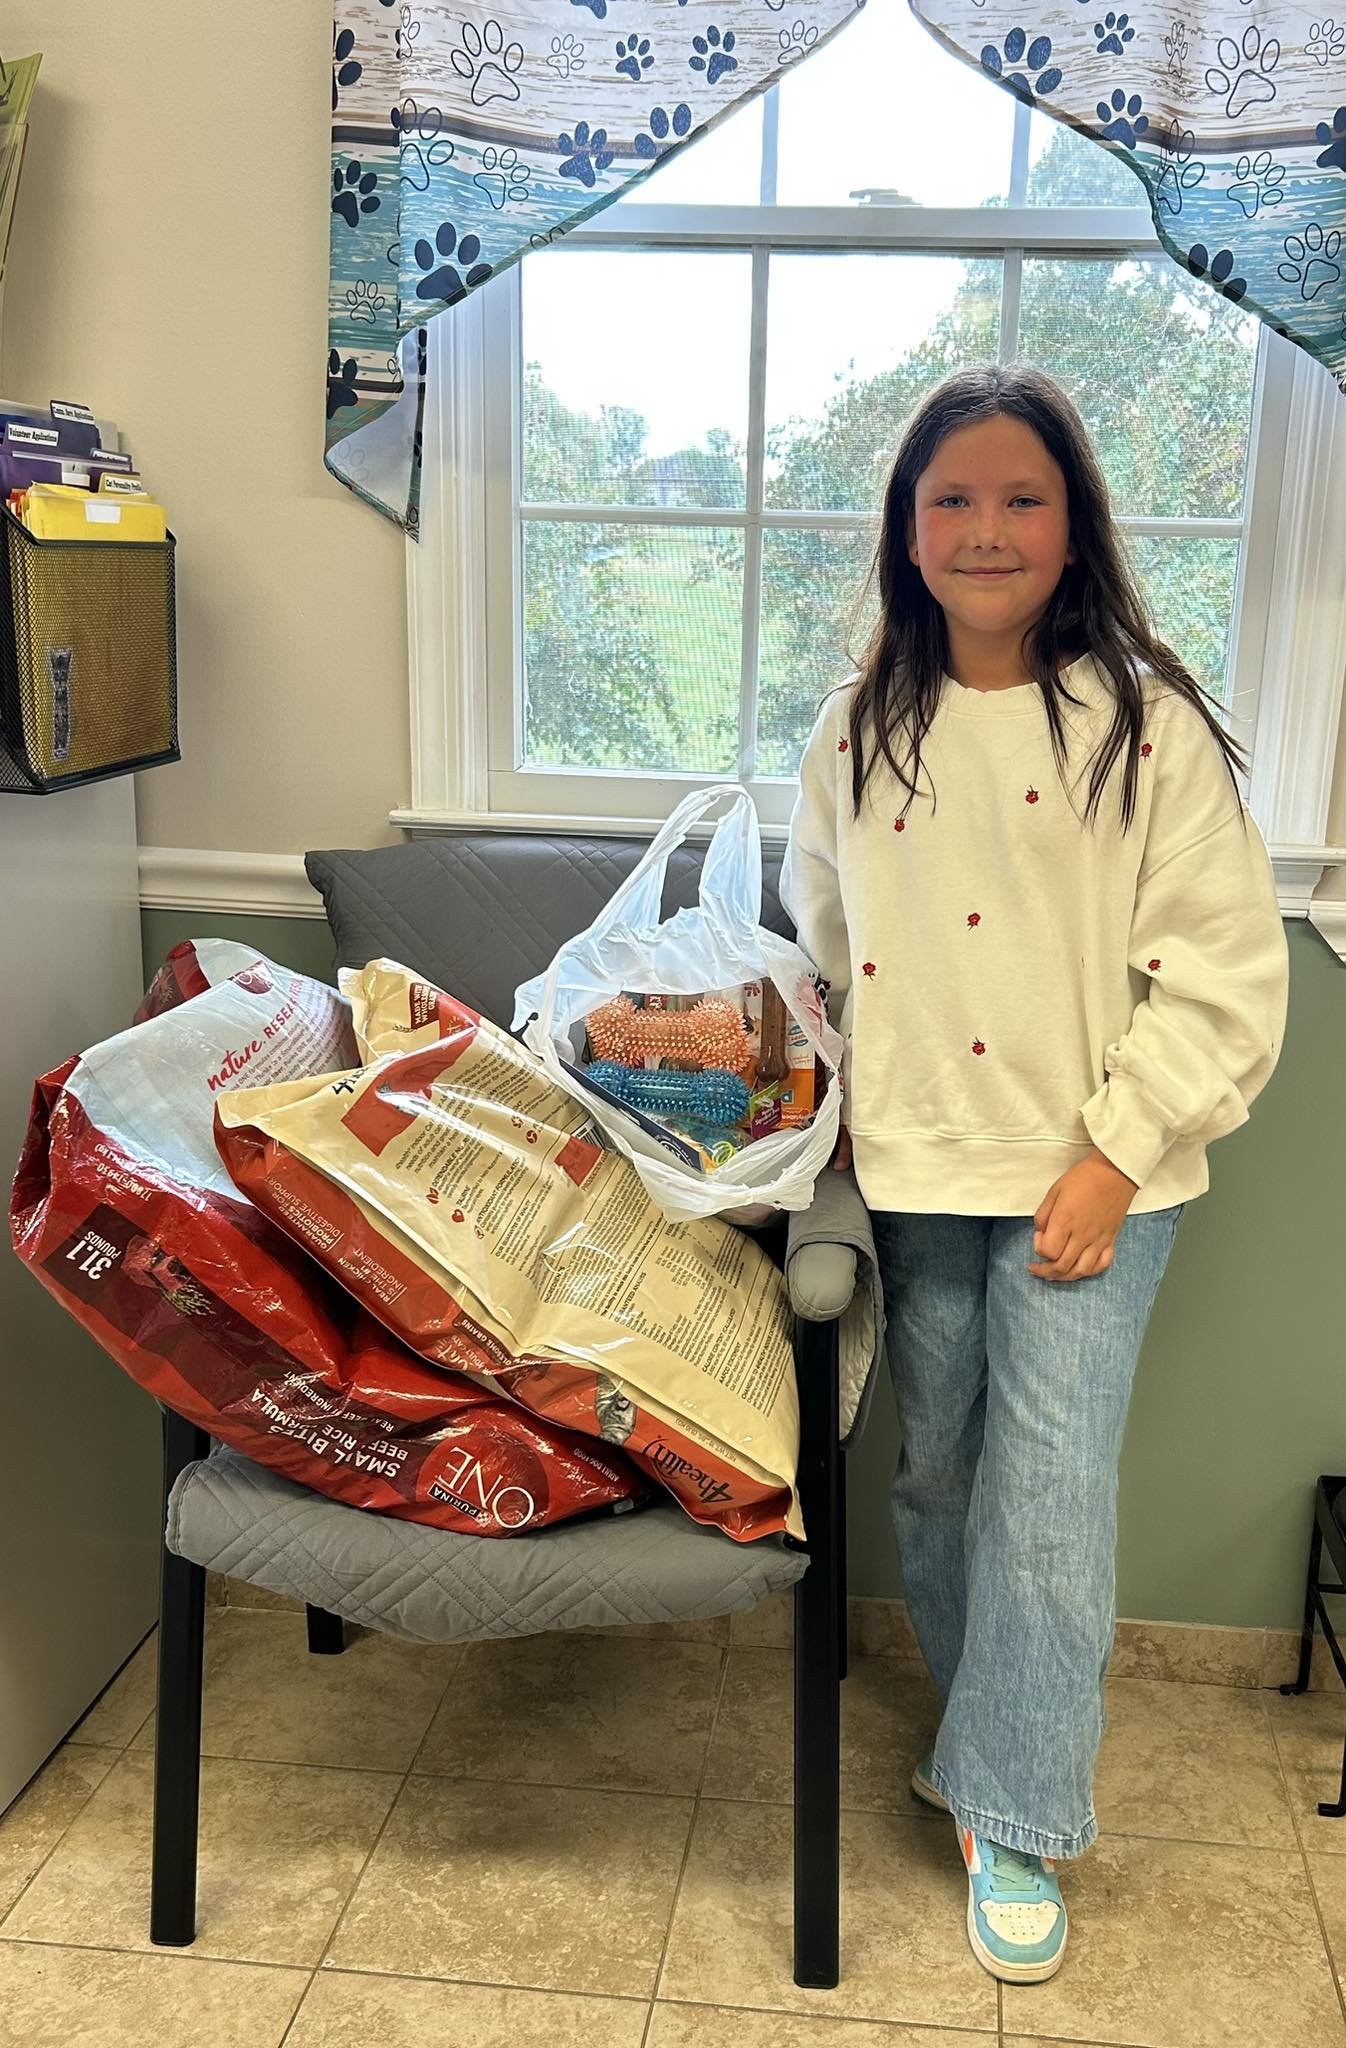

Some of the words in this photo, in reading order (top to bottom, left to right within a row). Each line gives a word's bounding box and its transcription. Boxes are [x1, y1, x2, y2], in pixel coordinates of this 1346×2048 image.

[9, 428, 31, 438] Volunteer
[414, 1150, 432, 1174] nutrition
[428, 1144, 447, 1168] maintain
[431, 1152, 457, 1187] DEPENDABLE
[264, 1174, 301, 1205] SUPPORT
[271, 1191, 289, 1207] FOR
[278, 1205, 327, 1249] GUARANTEED
[288, 1205, 333, 1243] PROBIOTICS
[299, 1203, 340, 1236] DIGESTIVE
[84, 1230, 121, 1259] POUNDS
[494, 1245, 504, 1257] OUR
[65, 1239, 112, 1280] 31.1
[337, 1257, 371, 1283] CHICKEN
[353, 1247, 403, 1290] INGREDIENT
[360, 1264, 370, 1274] #1
[370, 1272, 387, 1288] THE
[370, 1282, 390, 1302] REAL
[385, 1286, 397, 1297] IS
[461, 1318, 487, 1341] GRAINS
[465, 1348, 483, 1368] ADULT
[701, 1351, 715, 1372] CALORIE
[718, 1365, 730, 1383] AAFCO
[726, 1341, 741, 1366] STATEMENT
[741, 1375, 755, 1399] CHANGING
[321, 1423, 357, 1450] RICE
[369, 1438, 408, 1459] BEEF
[572, 1447, 590, 1462] FOOD
[588, 1457, 602, 1469] DOG
[601, 1465, 619, 1481] ADULT
[650, 1442, 733, 1502] 4health
[436, 1445, 533, 1527] ONE
[434, 1487, 479, 1516] PURINA
